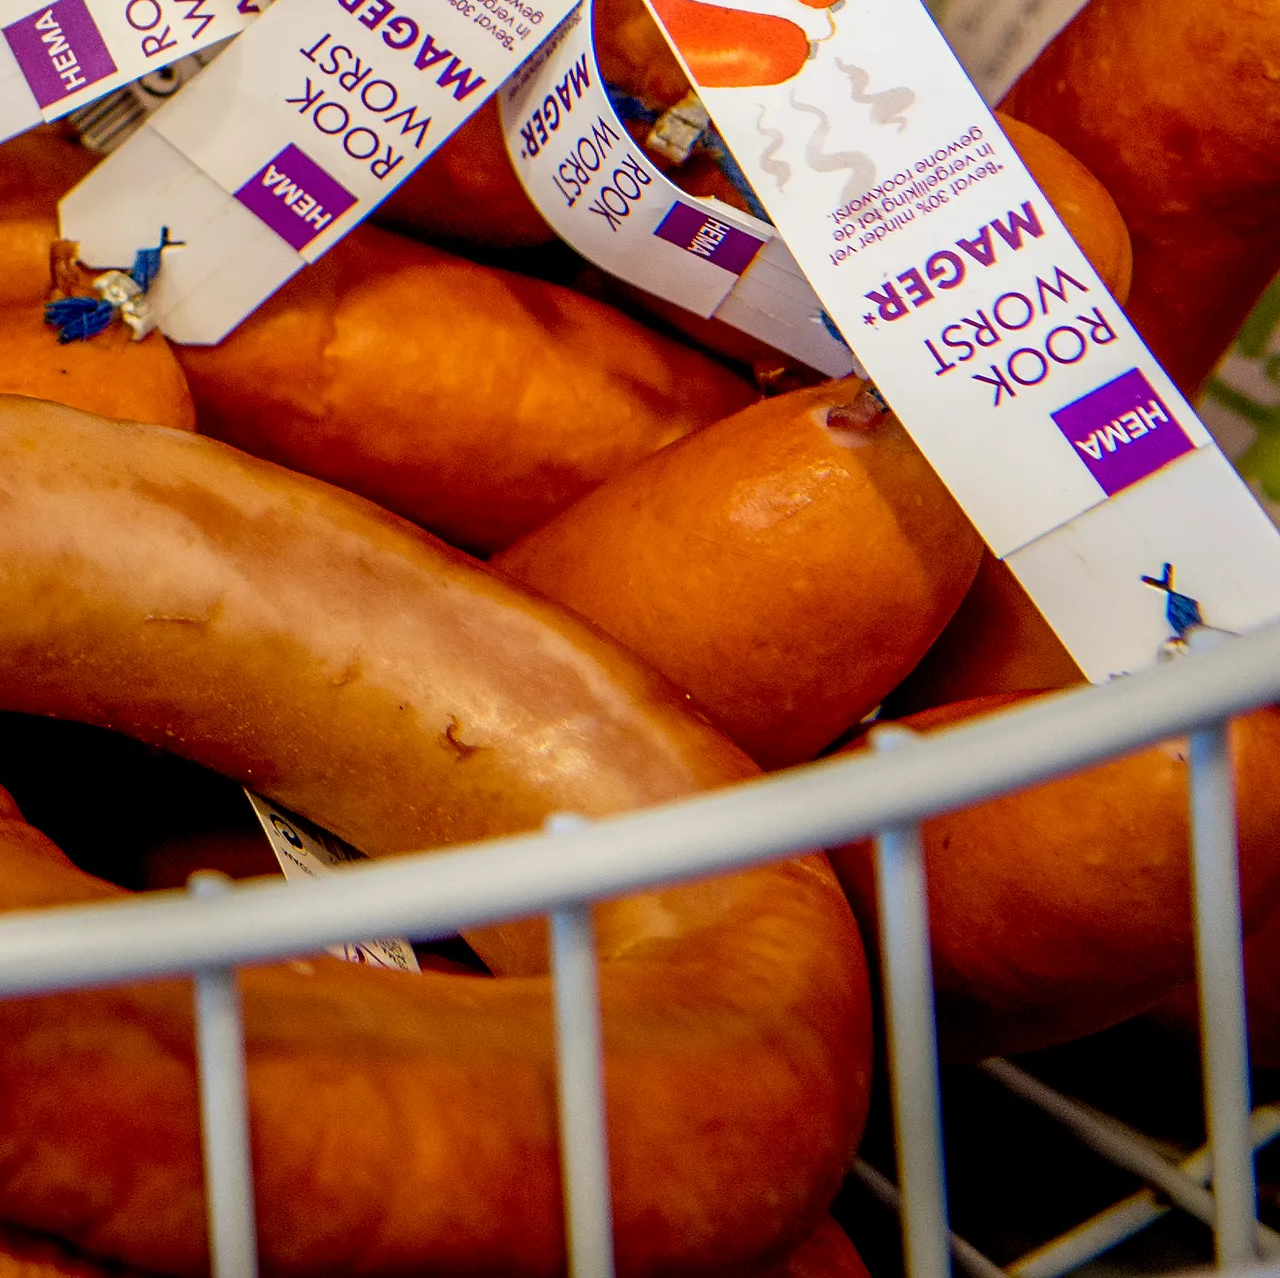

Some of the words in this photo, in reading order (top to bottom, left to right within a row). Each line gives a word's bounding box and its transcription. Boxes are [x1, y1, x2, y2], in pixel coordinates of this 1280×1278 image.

[35, 9, 86, 91] HEMA
[515, 22, 532, 41] in
[299, 32, 432, 150] WORST
[284, 76, 405, 180] ROOK
[914, 125, 983, 173] gewone
[976, 142, 996, 158] in
[552, 114, 621, 208] WORST
[881, 154, 977, 213] vergelijking
[260, 164, 332, 231] HEMA
[588, 153, 652, 233] ROOK
[858, 208, 884, 230] tot
[915, 189, 950, 215] 30%
[688, 217, 731, 258] HEMA
[829, 244, 858, 267] vet
[833, 223, 856, 242] de
[859, 208, 916, 249] minder
[923, 265, 1090, 377] WORST
[971, 306, 1119, 408] ROOK
[1075, 398, 1170, 461] HEMA
